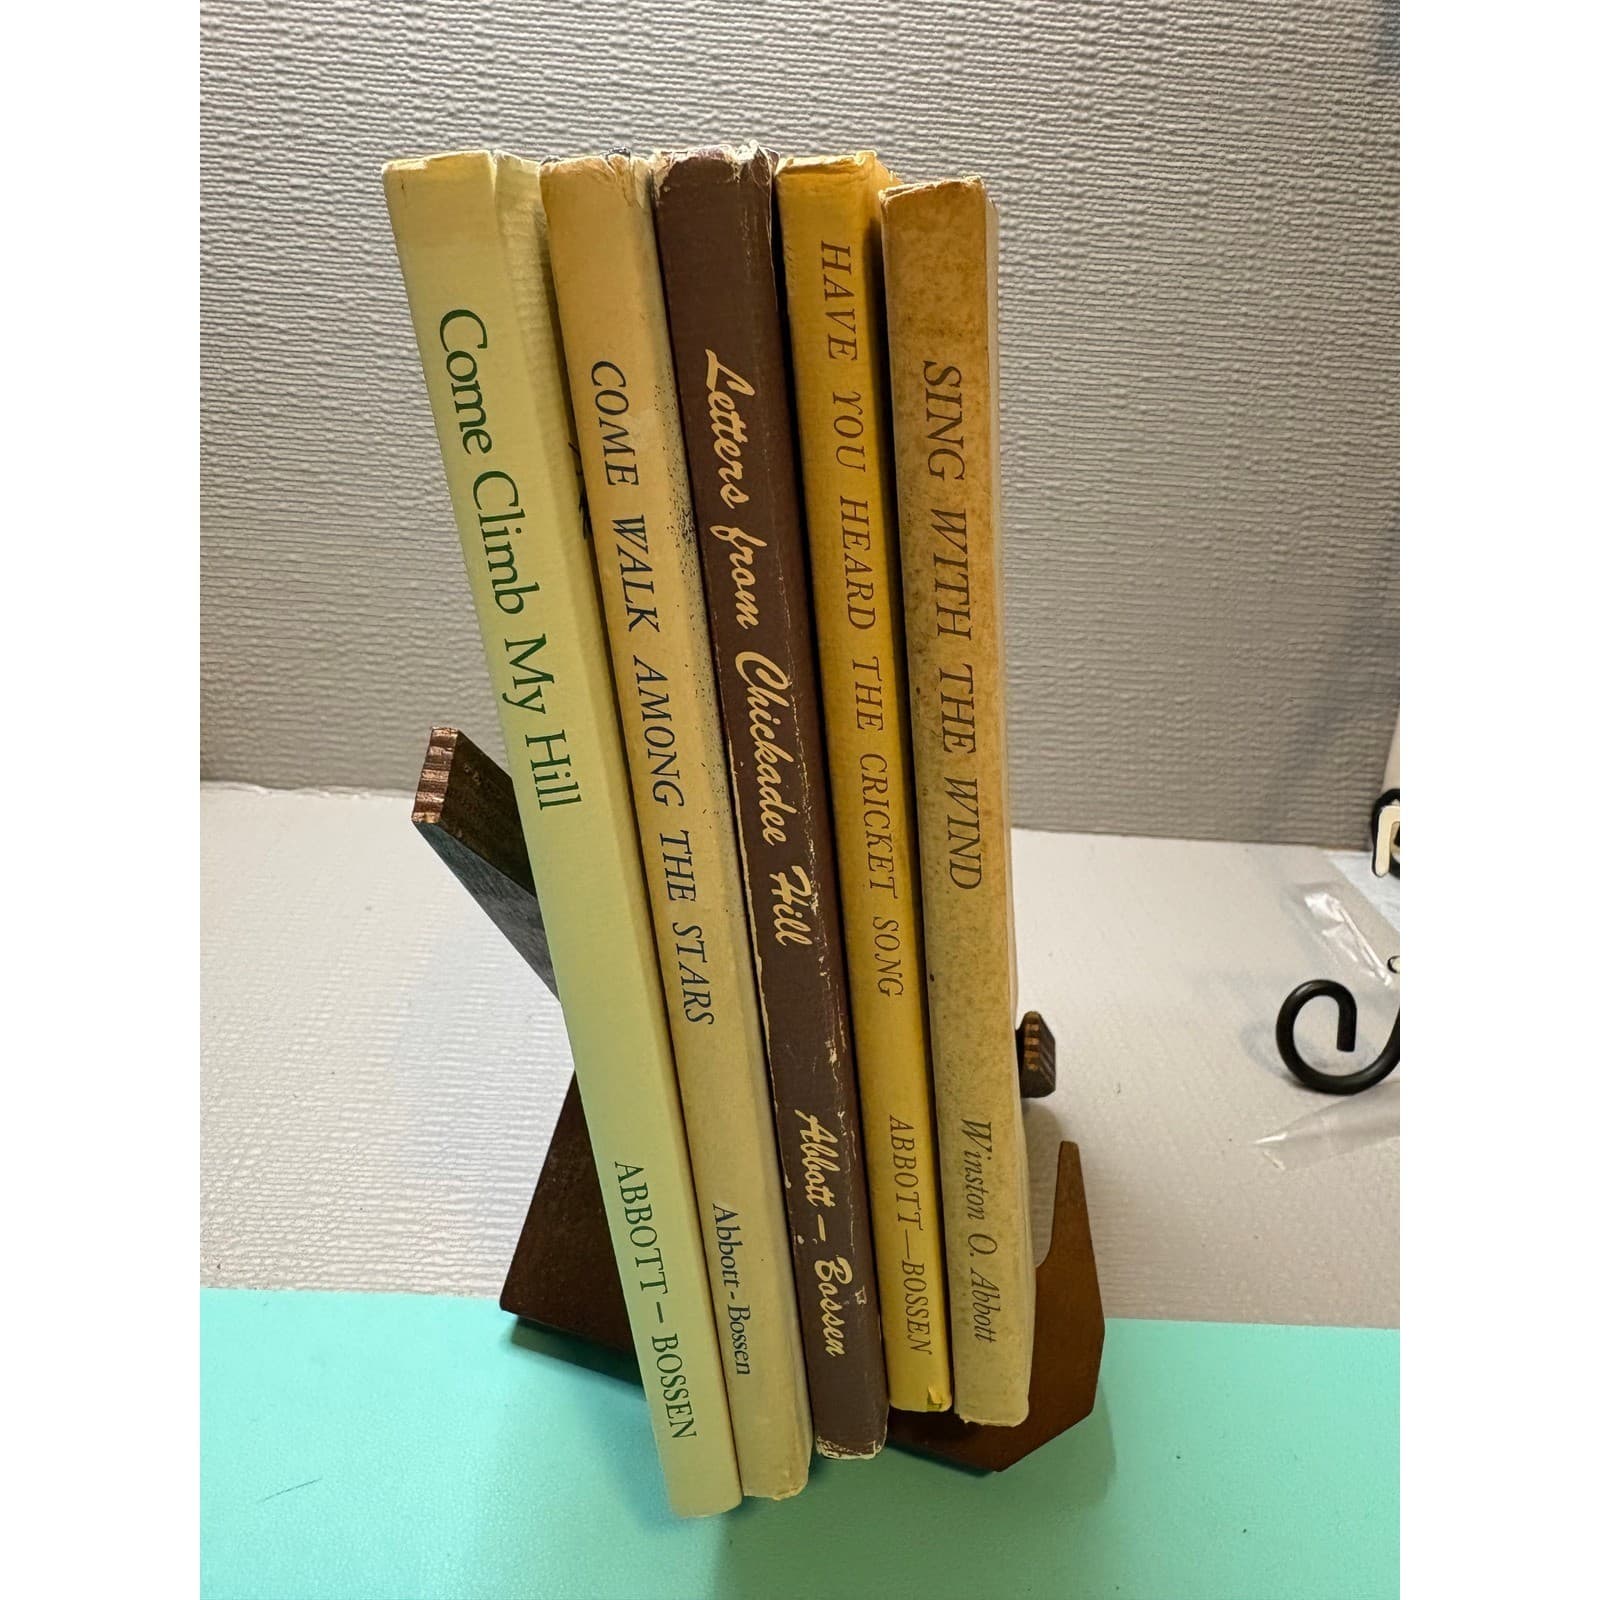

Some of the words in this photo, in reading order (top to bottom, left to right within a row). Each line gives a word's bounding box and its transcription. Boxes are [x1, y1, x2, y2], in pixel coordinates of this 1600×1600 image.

[821, 240, 858, 361] HAVE
[439, 309, 493, 454] Come
[591, 360, 640, 487] COME
[705, 348, 755, 510] Letters
[832, 391, 866, 473] YOU
[923, 360, 965, 481] SING
[473, 470, 540, 614] Climb
[613, 515, 659, 633] WALK
[710, 522, 767, 629] from
[839, 496, 877, 630] HEARD
[930, 508, 972, 642] WITH
[502, 633, 555, 715] My
[852, 656, 884, 732] THE
[937, 663, 976, 755] THE
[526, 729, 582, 810] Hill
[633, 655, 685, 808] AMONG
[735, 650, 803, 847] Chickadee
[659, 831, 696, 903] THE
[859, 752, 899, 900] CRICKET
[943, 777, 982, 891] WIND
[767, 864, 813, 948] Hill
[872, 916, 905, 999] SONG
[672, 922, 714, 1026] STARS
[794, 1109, 839, 1208] Abbott
[961, 1117, 992, 1221] Winston
[967, 1232, 997, 1258] O.
[614, 1160, 669, 1294] ABBOTT
[651, 1333, 697, 1439] BOSSEN
[813, 1253, 854, 1357] Bossen
[970, 1268, 1001, 1345] Abbott
